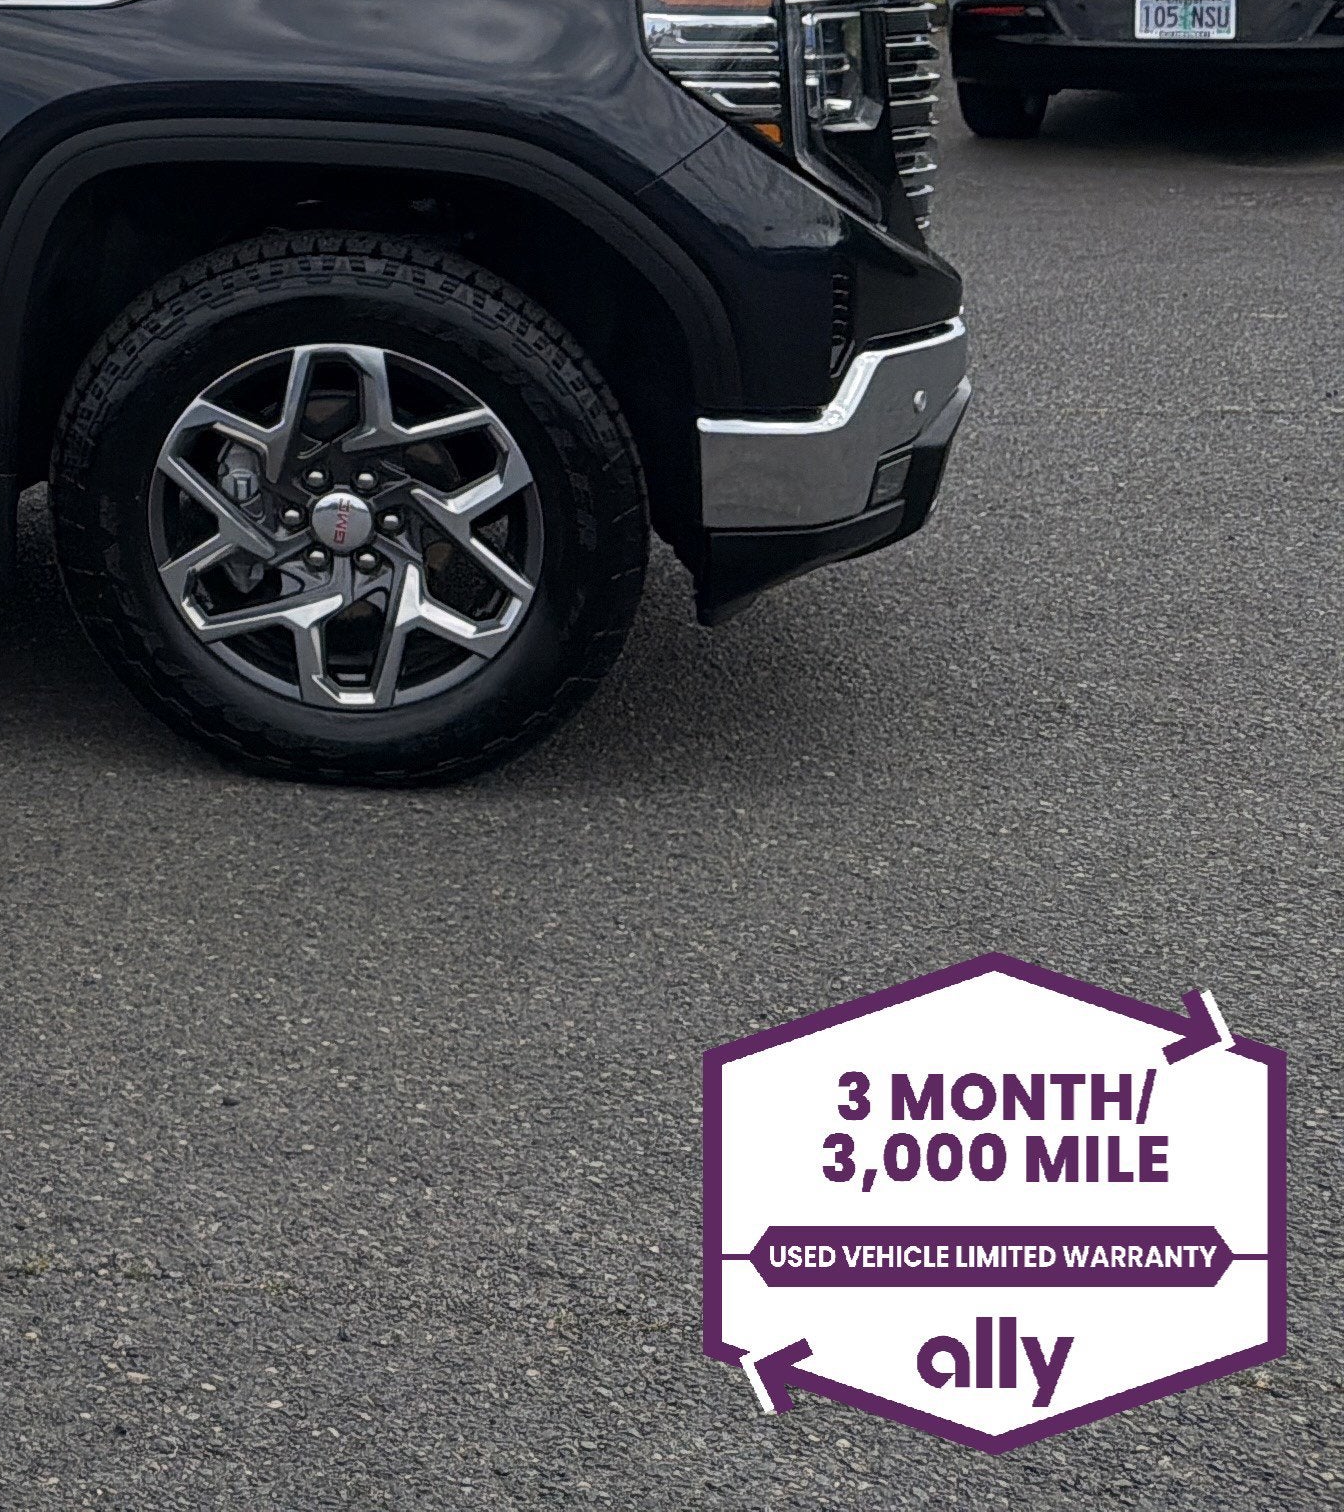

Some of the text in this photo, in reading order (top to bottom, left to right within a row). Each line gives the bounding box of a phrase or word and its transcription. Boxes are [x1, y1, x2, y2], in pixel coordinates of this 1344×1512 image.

[1143, 6, 1230, 29] 105 NSU
[333, 498, 351, 545] GMC
